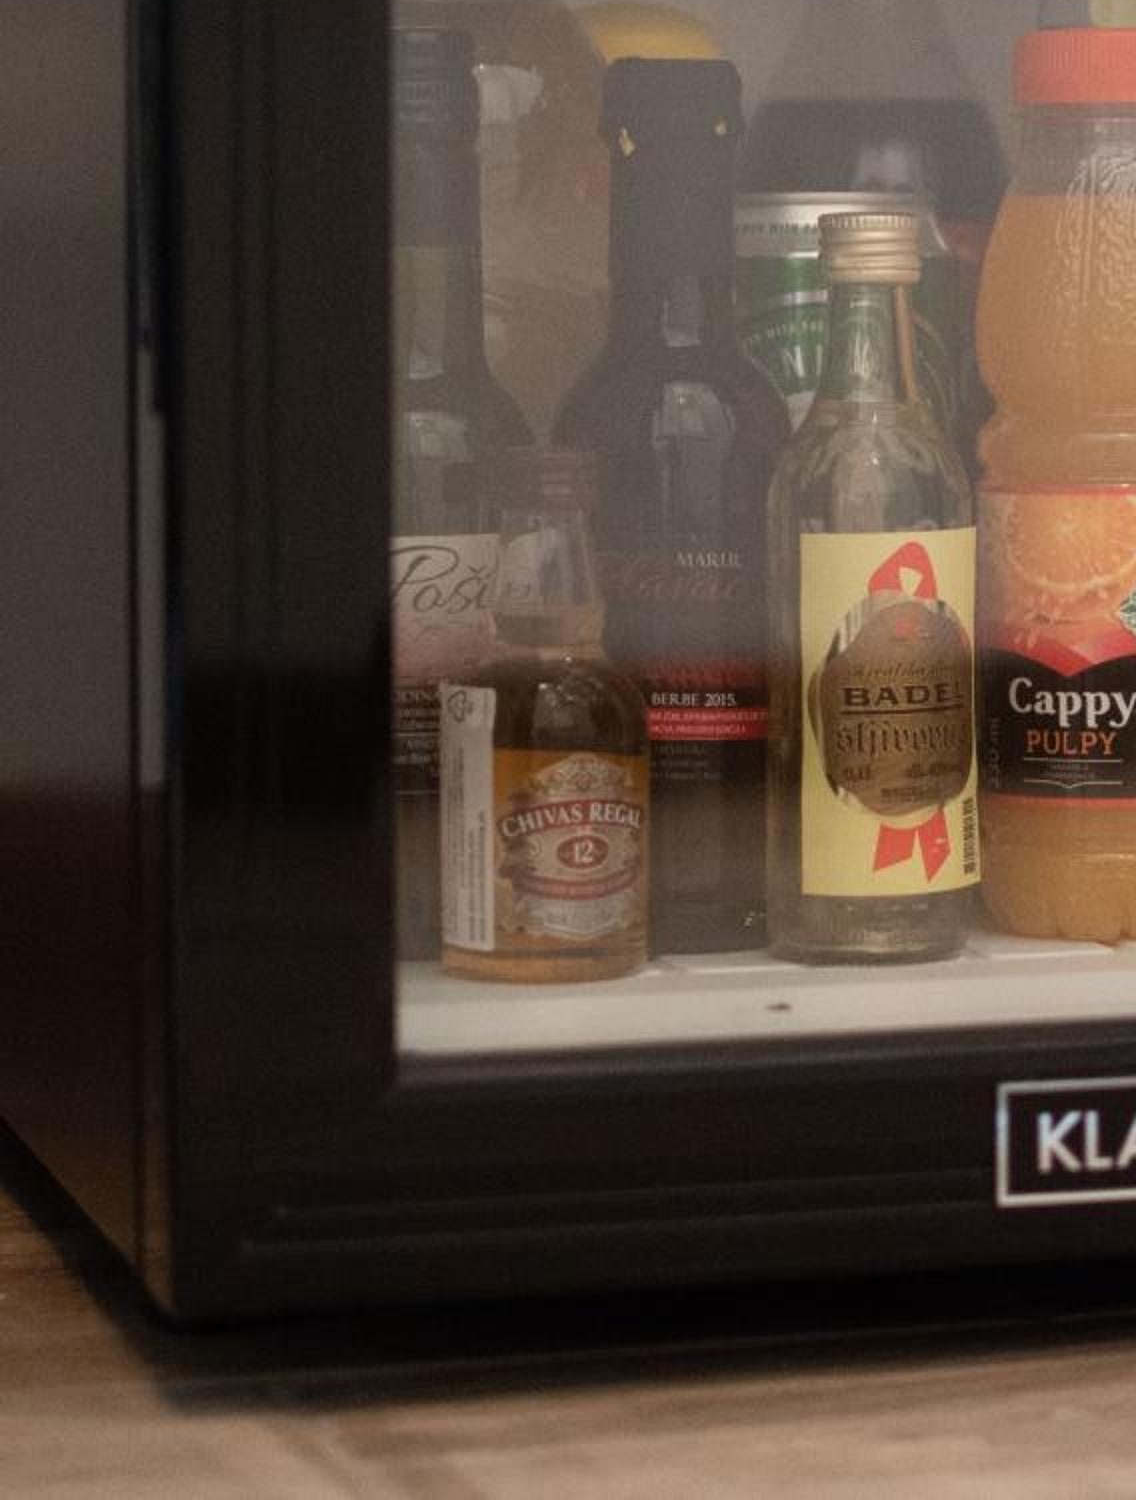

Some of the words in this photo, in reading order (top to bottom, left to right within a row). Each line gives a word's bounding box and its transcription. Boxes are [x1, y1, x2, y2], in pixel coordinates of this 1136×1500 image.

[840, 680, 967, 707] BADEL
[1024, 728, 1119, 757] PULPY
[502, 803, 583, 838] CHIVAS
[573, 840, 595, 864] 12
